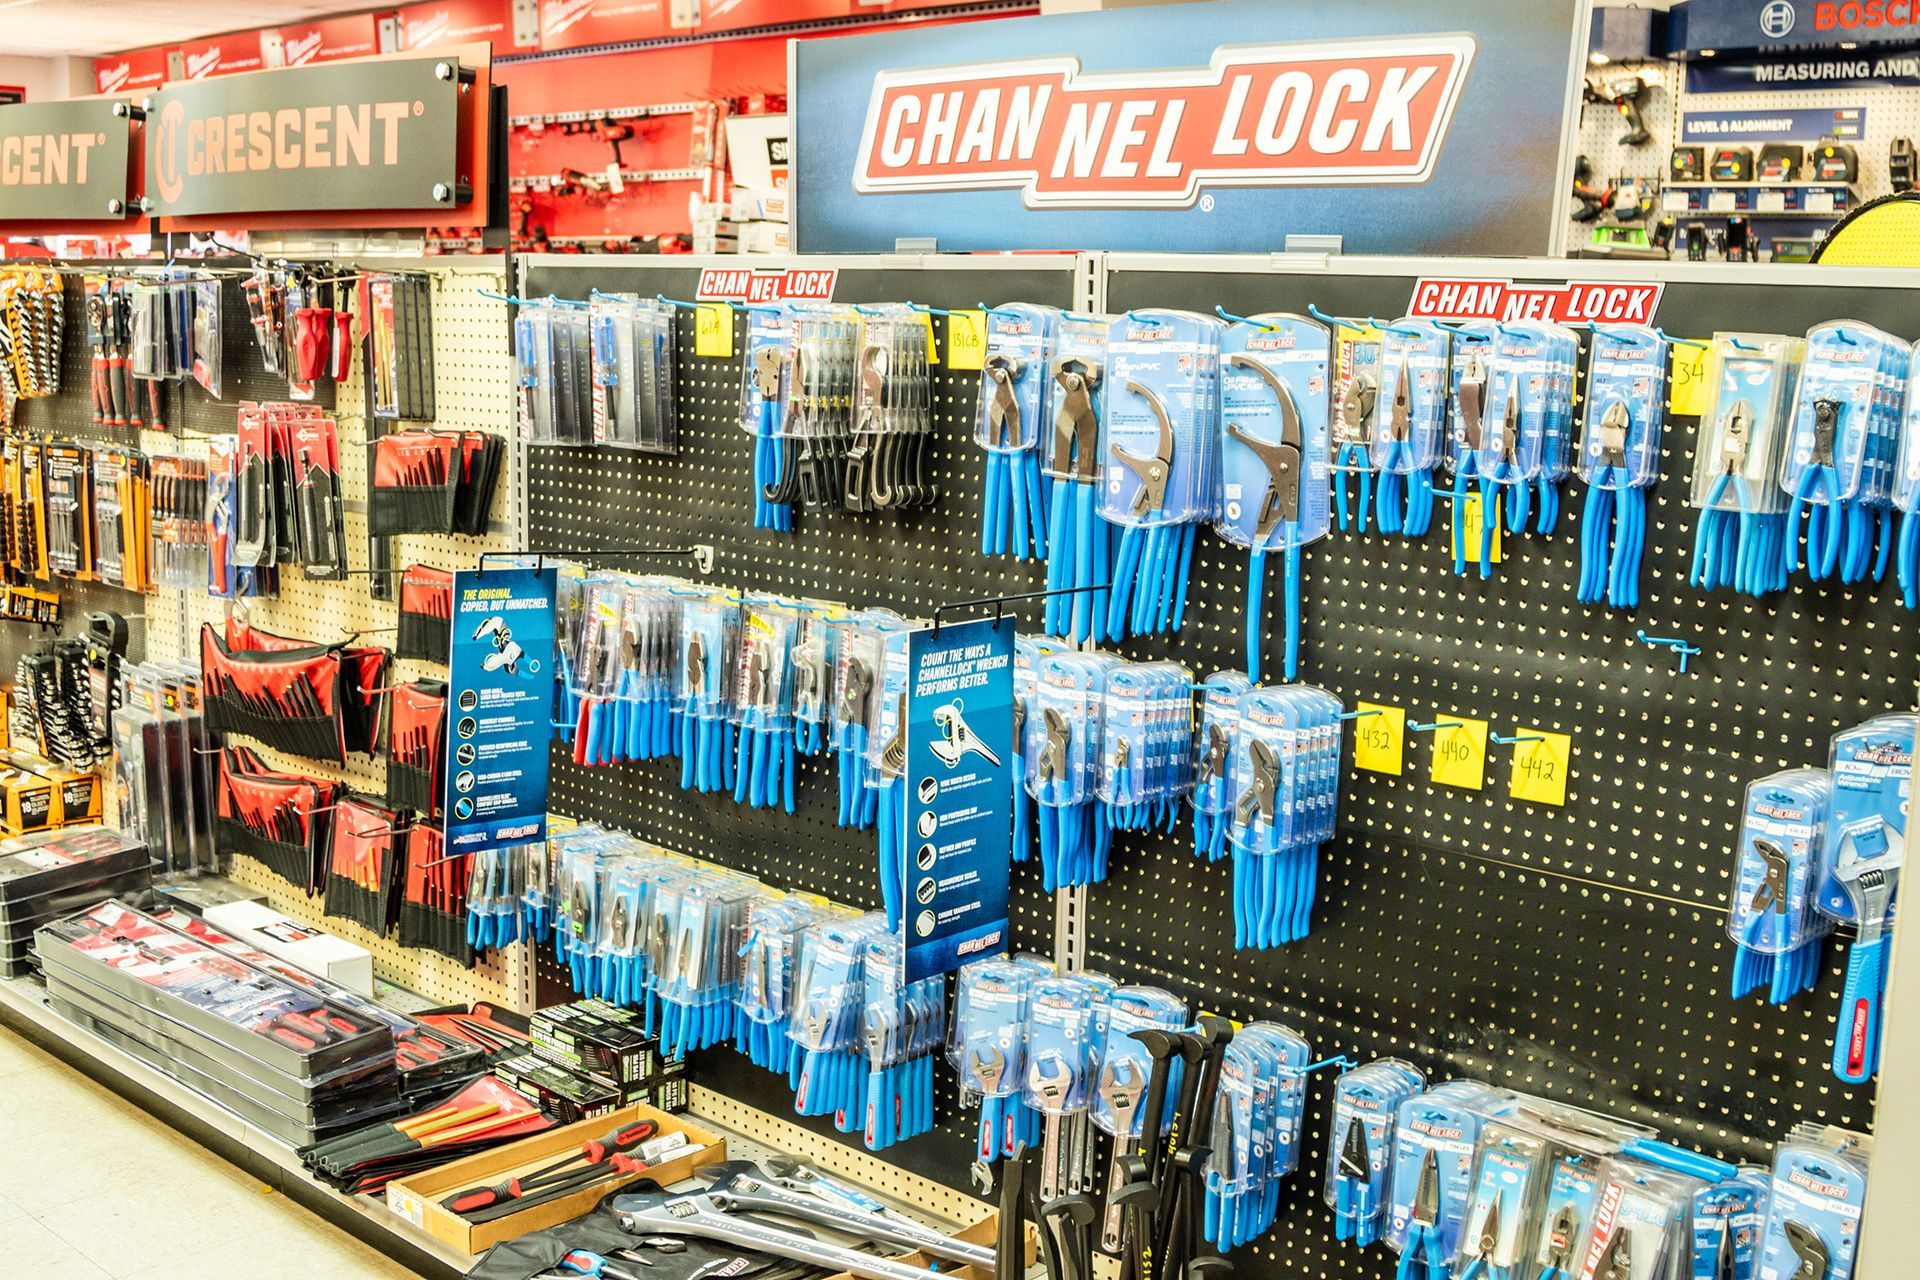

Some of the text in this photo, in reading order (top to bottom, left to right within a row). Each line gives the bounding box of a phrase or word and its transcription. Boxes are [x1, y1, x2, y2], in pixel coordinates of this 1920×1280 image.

[1756, 59, 1915, 82] MEASURING AND
[1688, 121, 1718, 133] LEVEL
[1730, 119, 1793, 132] ALIGNMENT
[188, 102, 409, 176] CRESCENT
[1678, 362, 1704, 385] 34
[464, 588, 512, 600] THE ORIGINAL.
[461, 598, 548, 613] COPIED, BUT UNMATCHED.
[921, 643, 992, 667] COUNT THE WAYS A
[976, 654, 1008, 671] WRENCH
[915, 672, 988, 697] PERFORMS BETTER.
[1363, 727, 1389, 749] 432
[1442, 740, 1469, 761] 440
[1521, 757, 1554, 781] 442
